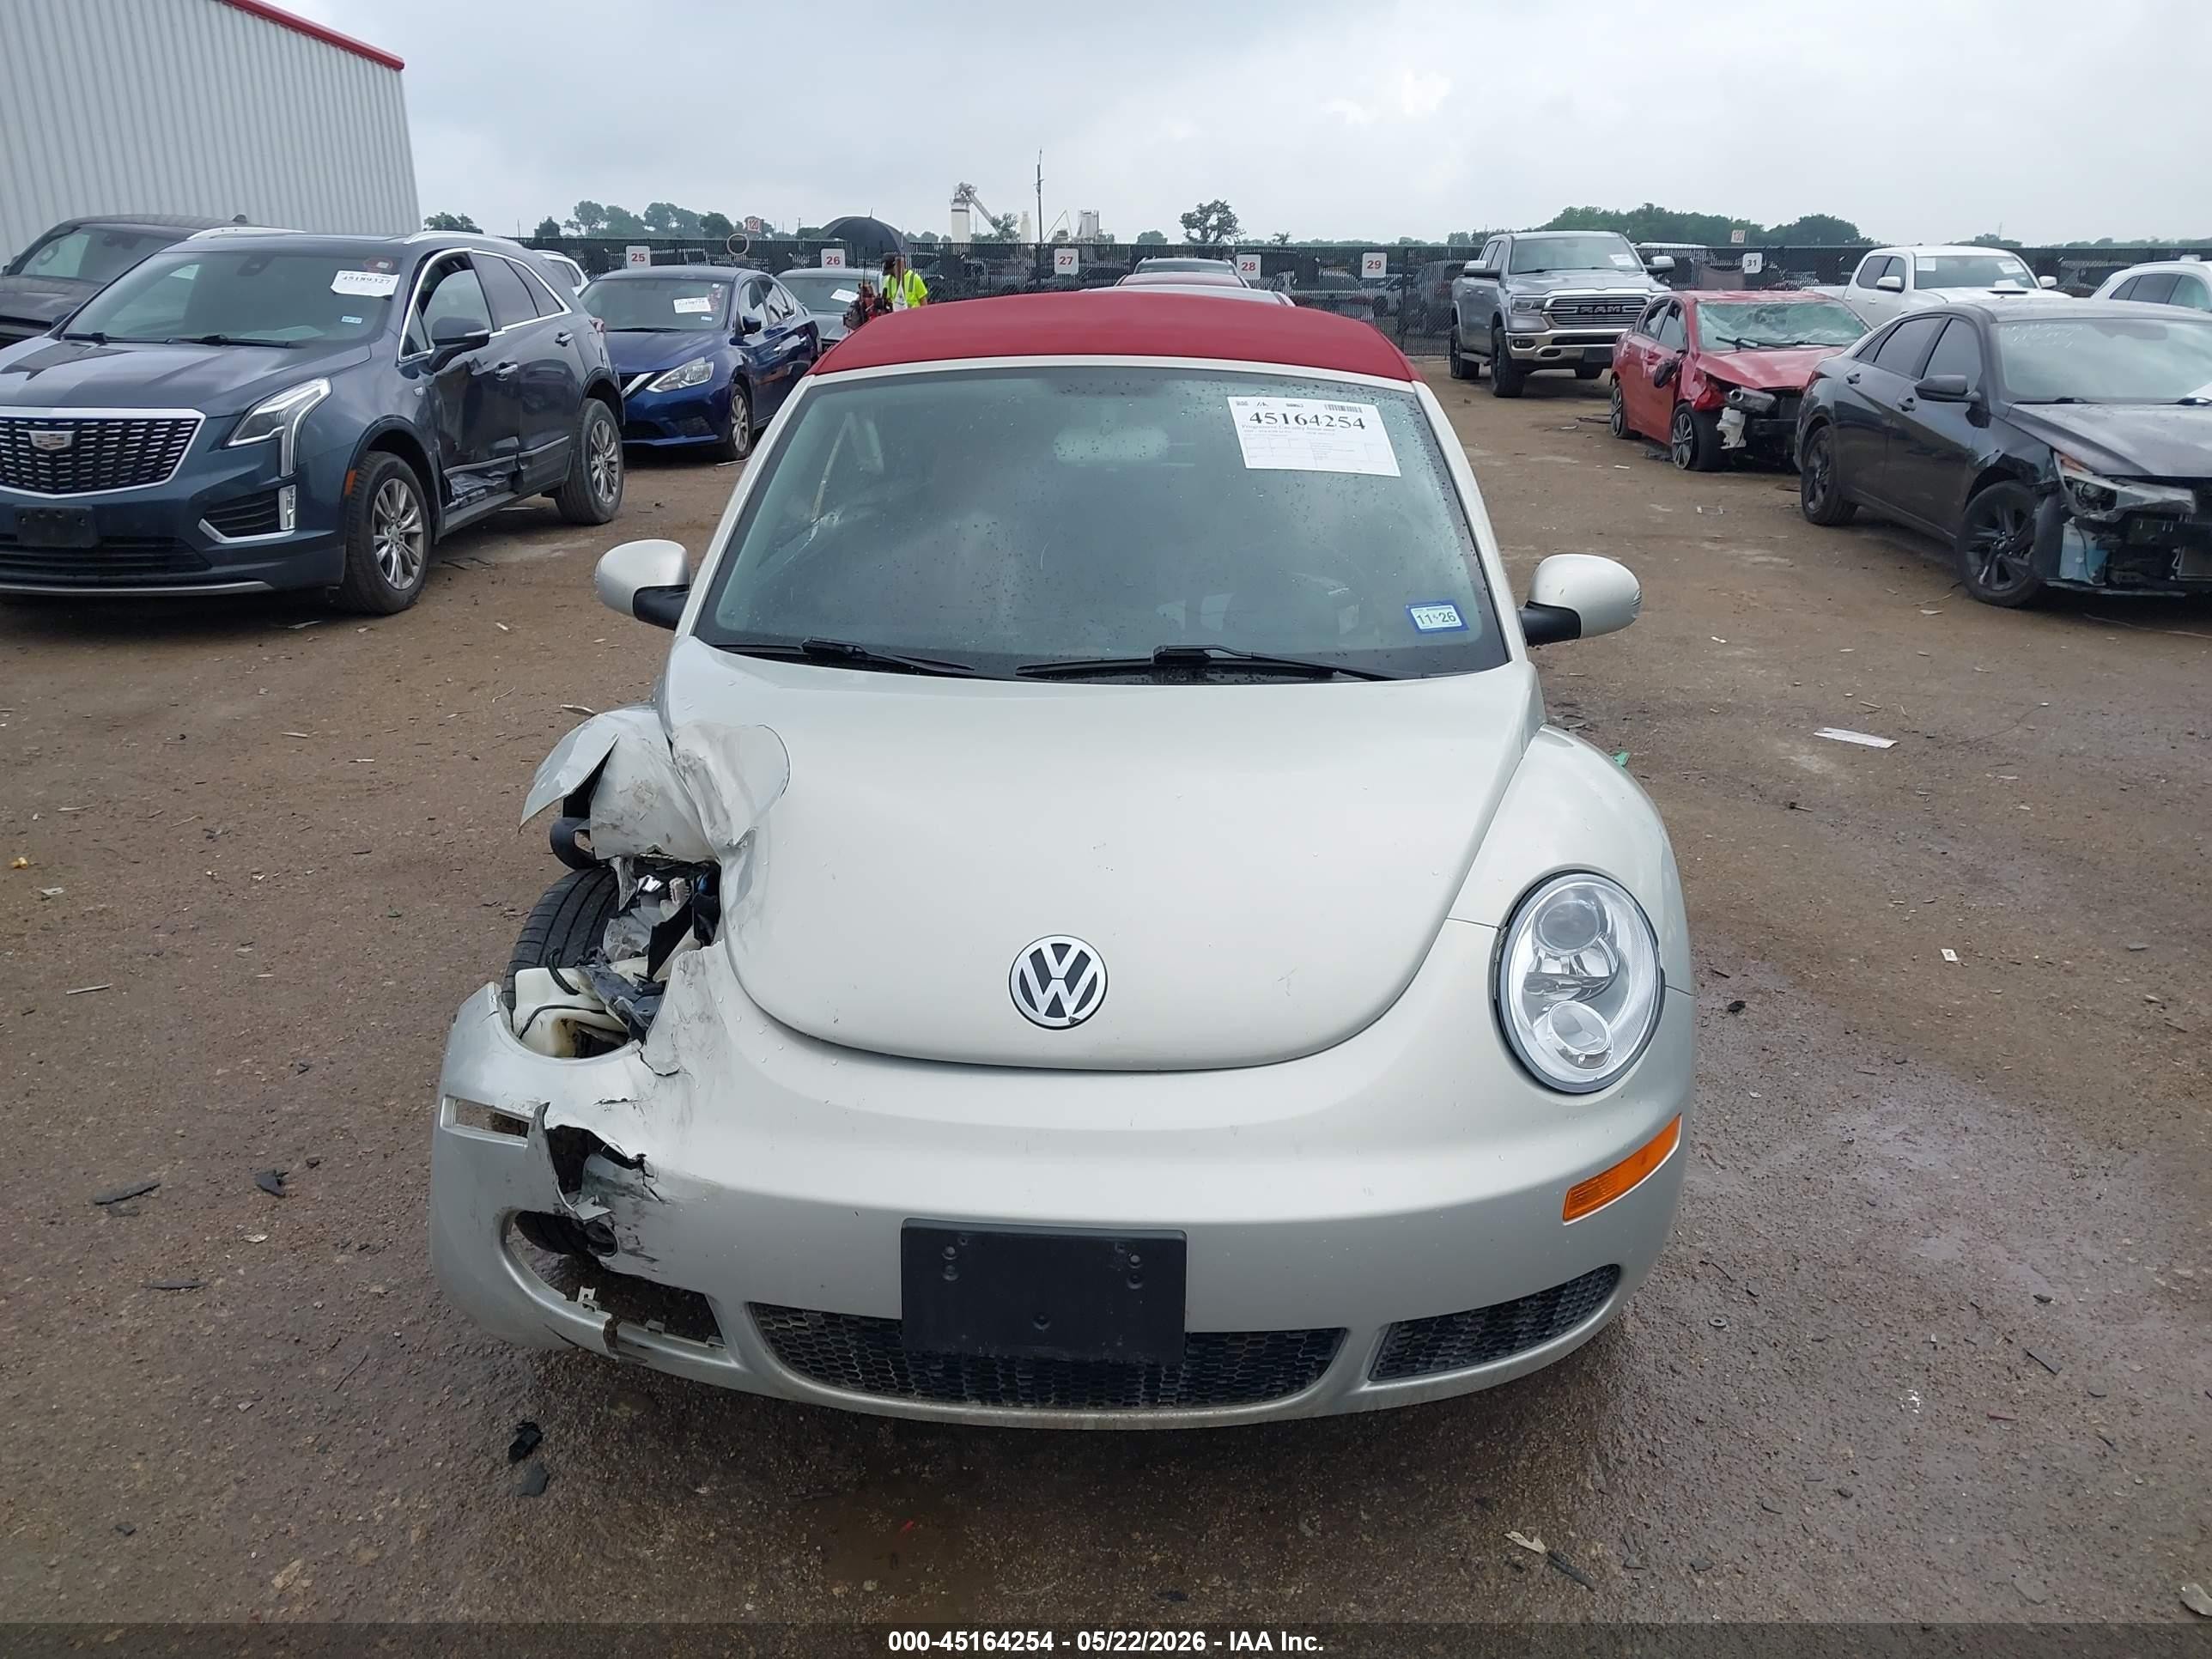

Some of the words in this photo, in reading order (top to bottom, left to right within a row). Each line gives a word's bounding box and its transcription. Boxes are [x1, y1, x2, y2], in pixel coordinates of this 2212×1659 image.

[631, 252, 646, 262] 25
[826, 256, 841, 265] 26
[1059, 256, 1073, 265] 27
[1242, 261, 1256, 271] 28
[1367, 260, 1382, 270] 29
[1747, 259, 1757, 268] 31
[1579, 306, 1621, 314] RAM
[1249, 411, 1366, 430] 45164254
